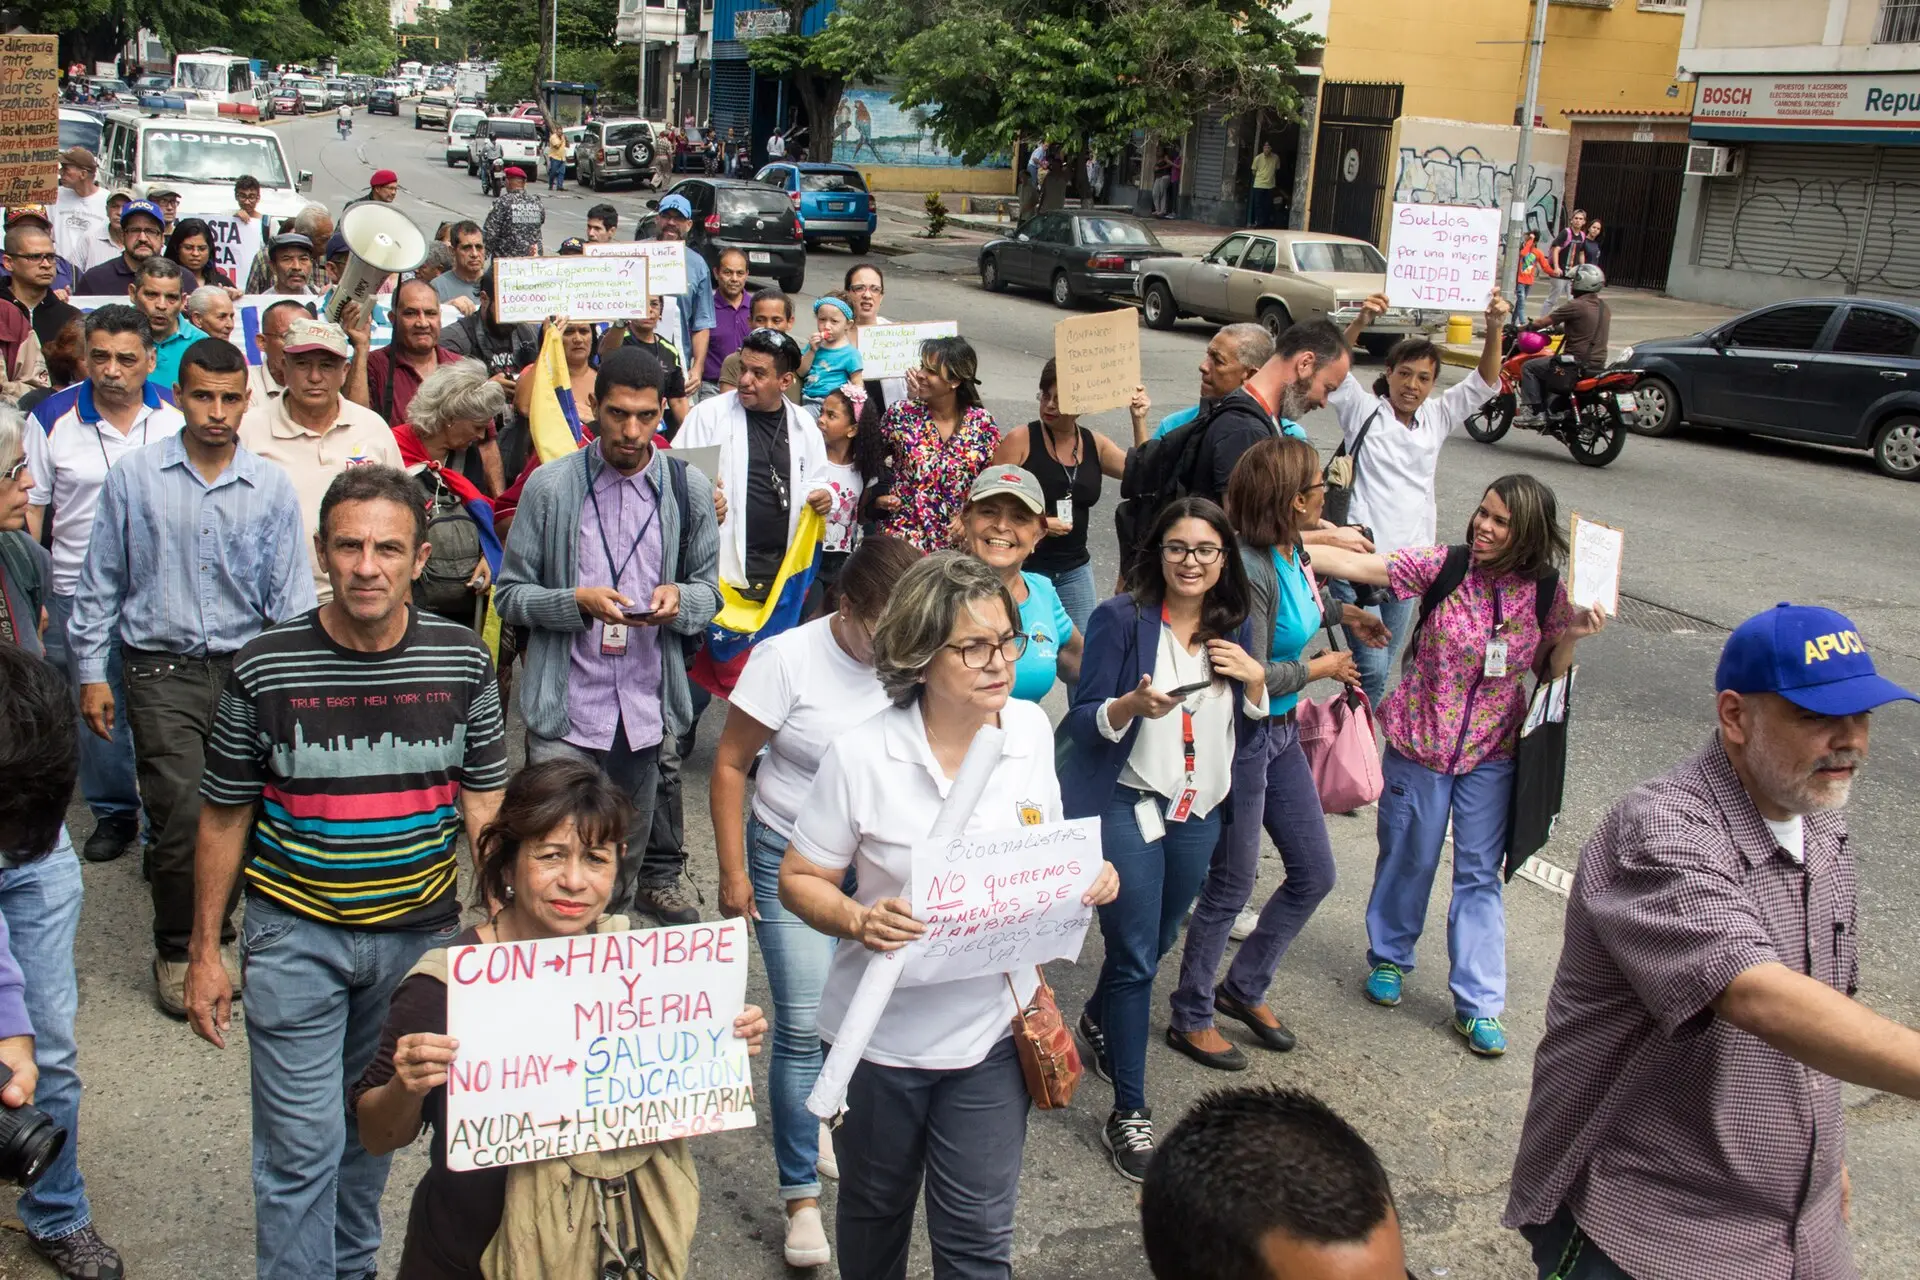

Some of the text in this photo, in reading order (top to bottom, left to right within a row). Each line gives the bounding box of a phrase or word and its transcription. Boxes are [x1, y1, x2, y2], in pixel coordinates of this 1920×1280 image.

[4, 37, 54, 53] diferencia
[2, 54, 33, 66] entre
[25, 68, 57, 80] estos
[1774, 83, 1805, 91] REPUESTOS
[1812, 83, 1848, 91] ACCESORIOS
[1702, 87, 1753, 105] BOSCH
[1804, 100, 1836, 108] TRACTORES
[1, 108, 58, 121] GENOCIDAS
[1700, 108, 1748, 118] Automotriz
[1776, 108, 1835, 116] MAQUINARIA PESADA
[24, 122, 58, 135] MUERTE
[28, 136, 59, 149] MUERTE
[32, 176, 45, 189] de
[1432, 230, 1489, 248] Dignos
[1423, 249, 1445, 259] una
[1451, 251, 1488, 265] mejor
[1393, 263, 1491, 283] CALIDAD DE
[289, 692, 452, 709] TRUE EAST NEW YORK CITY
[927, 871, 966, 902] NO
[1037, 883, 1073, 905] DE
[453, 926, 736, 985] CON HAMBRE
[619, 973, 642, 1005] Y
[574, 991, 713, 1041] MISERIA
[585, 1030, 700, 1076] SALUD
[449, 1054, 553, 1096] NO HAY
[449, 1085, 755, 1154] AYUDA HUMANITARIA
[607, 1126, 659, 1146] YA!!!
[670, 1111, 726, 1138] SOS
